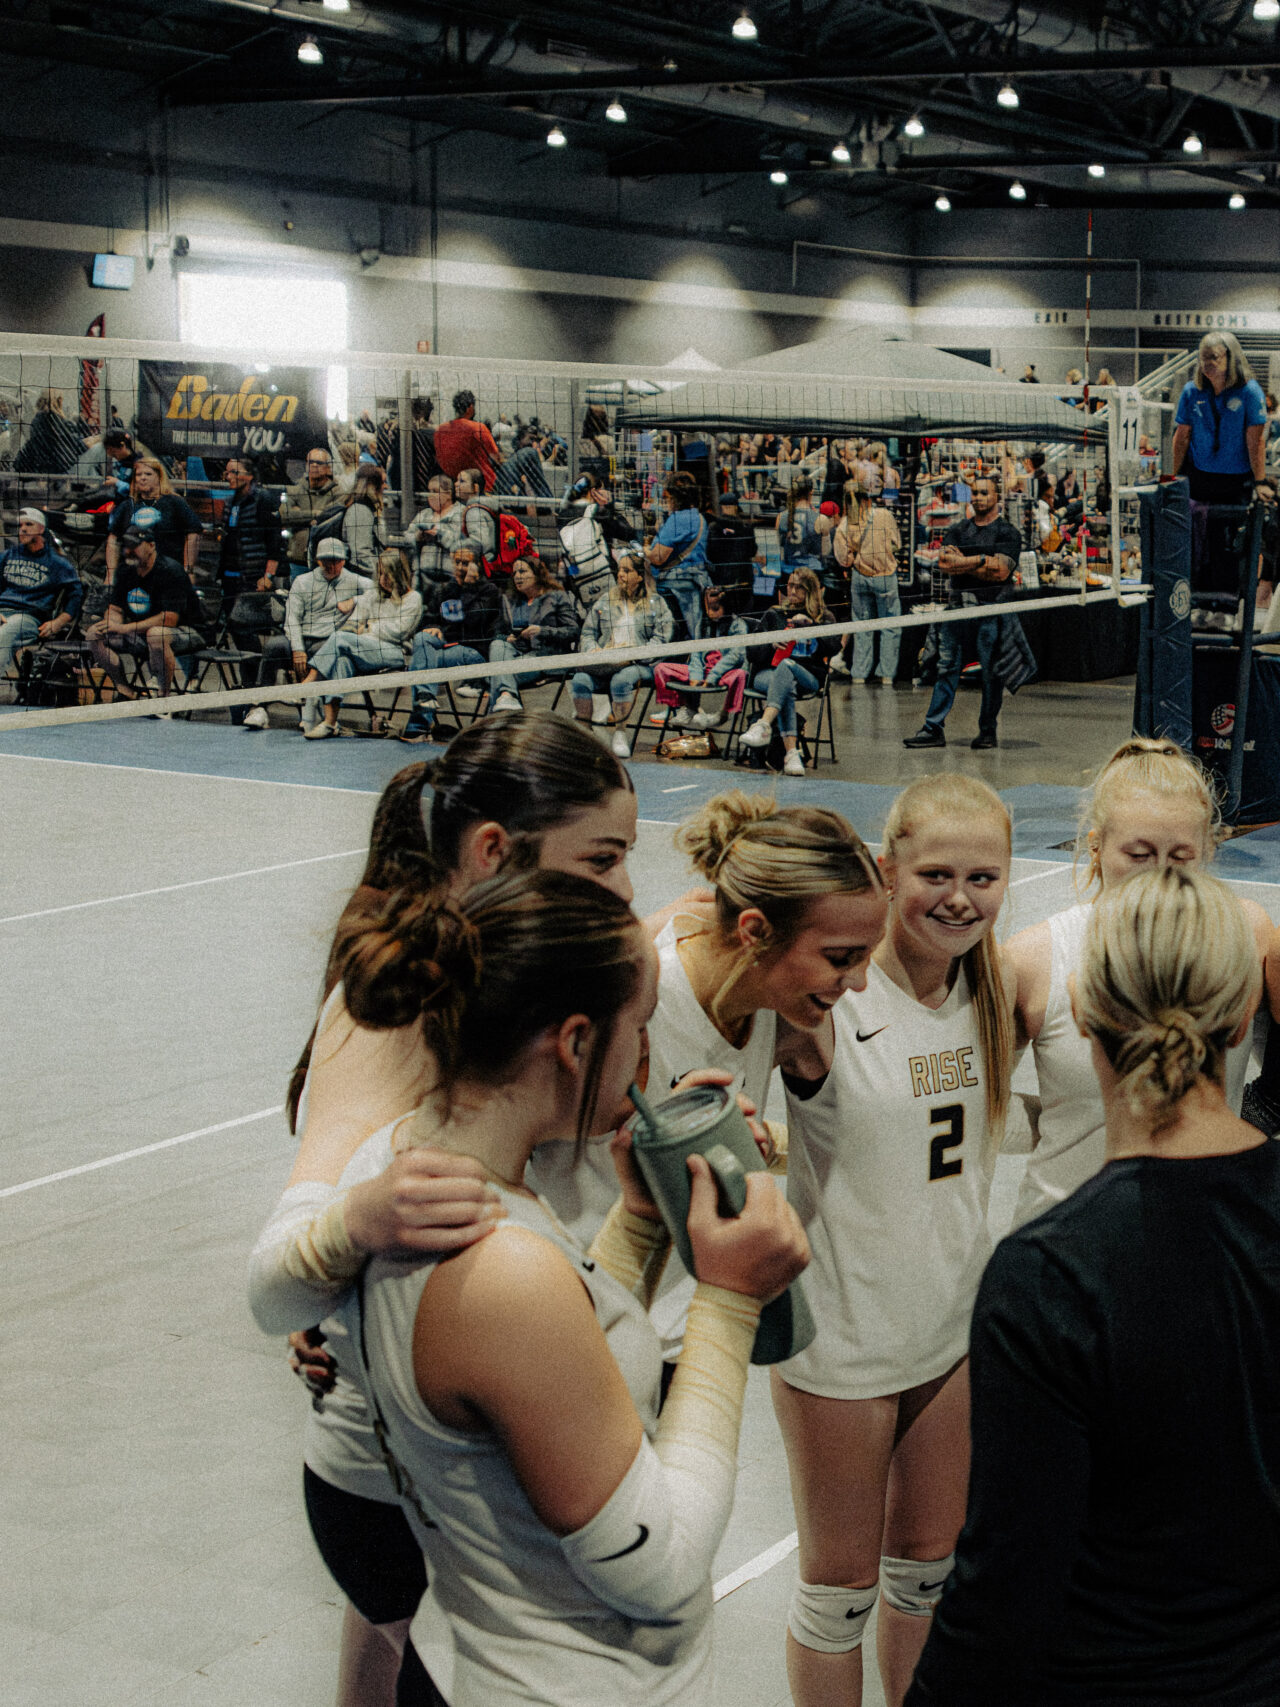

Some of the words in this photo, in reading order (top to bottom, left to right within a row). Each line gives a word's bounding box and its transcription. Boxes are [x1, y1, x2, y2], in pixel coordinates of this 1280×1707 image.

[1034, 312, 1068, 324] EXIT
[1153, 313, 1248, 327] RESTROOMS
[165, 375, 298, 422] Baden
[172, 430, 186, 445] THE
[1123, 417, 1138, 451] 11
[908, 1046, 979, 1098] RISE
[928, 1102, 964, 1183] 2
